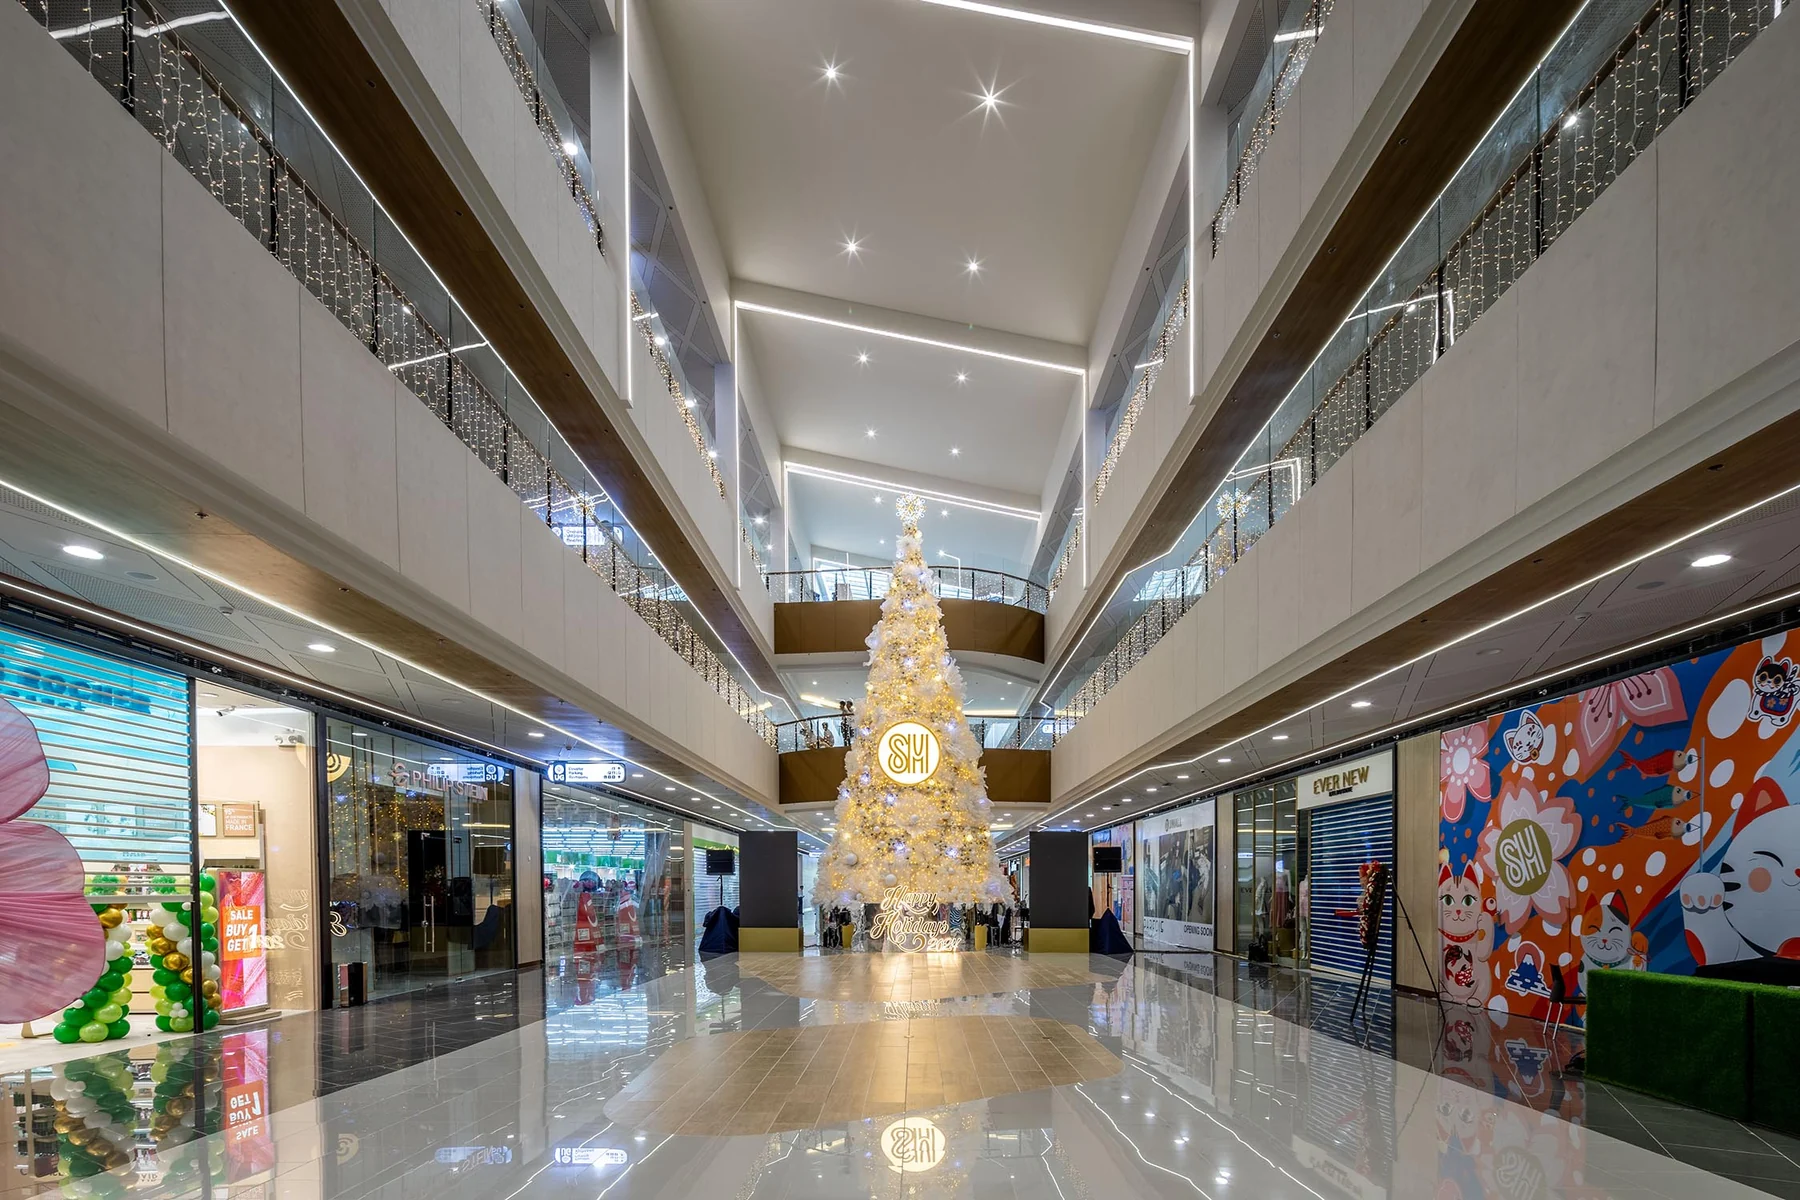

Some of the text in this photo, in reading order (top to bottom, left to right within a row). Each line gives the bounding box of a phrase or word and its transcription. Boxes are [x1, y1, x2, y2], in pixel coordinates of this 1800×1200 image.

[888, 733, 929, 774] SM
[1313, 774, 1340, 794] EVER
[1343, 765, 1370, 788] NEW
[1499, 823, 1548, 888] SM
[880, 885, 940, 915] Happy
[230, 910, 254, 920] SALE
[226, 924, 248, 937] BUY
[248, 924, 259, 949] 1
[870, 910, 949, 953] Holidays
[1184, 924, 1213, 937] OPENING SOON
[227, 938, 248, 952] GET
[927, 937, 962, 952] 2024
